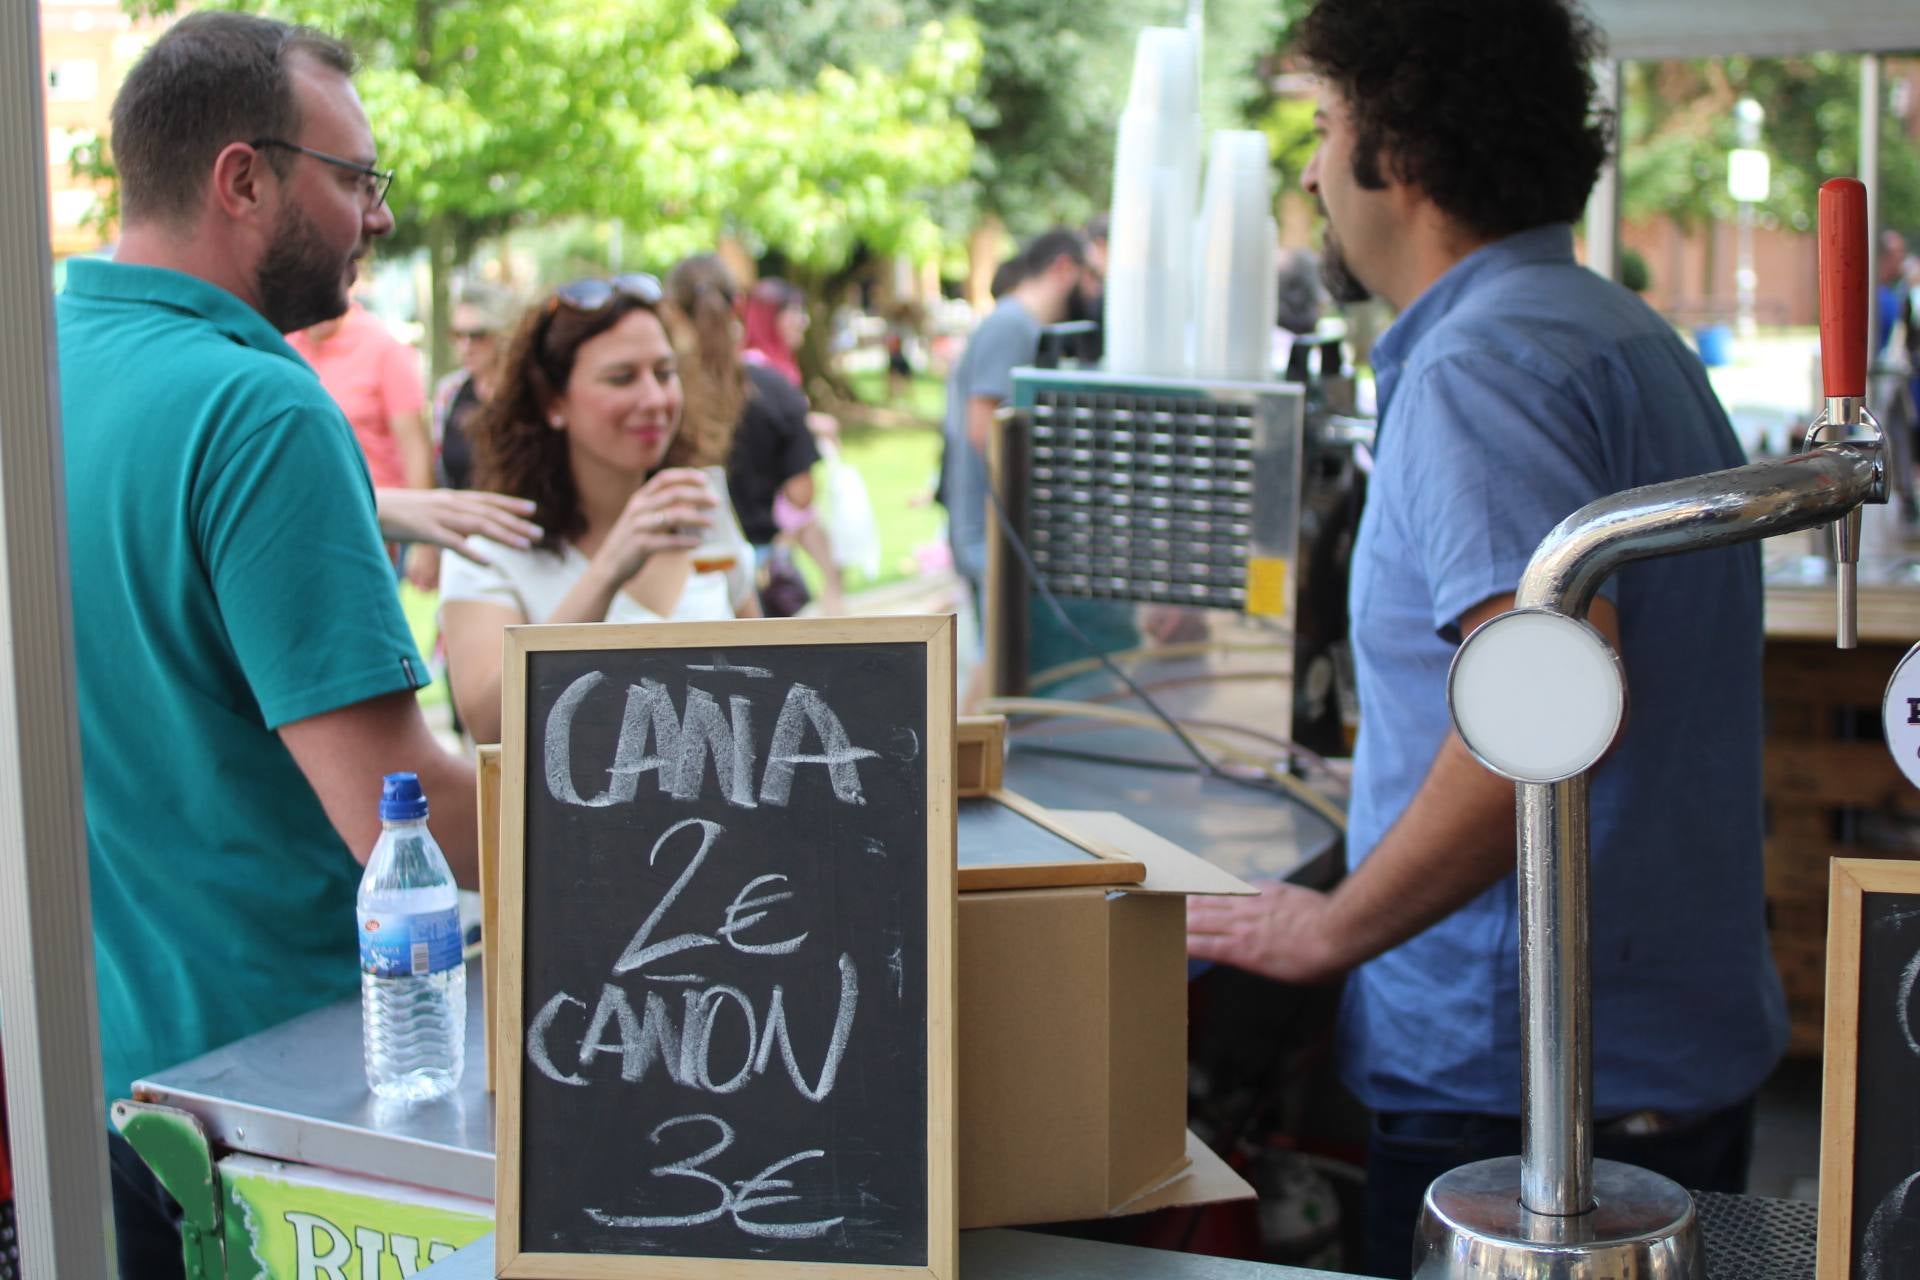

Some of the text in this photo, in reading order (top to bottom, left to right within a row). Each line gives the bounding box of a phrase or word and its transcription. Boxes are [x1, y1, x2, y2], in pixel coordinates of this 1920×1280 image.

[544, 663, 882, 808] CAÑA
[612, 817, 809, 975] 2€
[526, 953, 859, 1102] CAÑON
[584, 1112, 844, 1239] 3€
